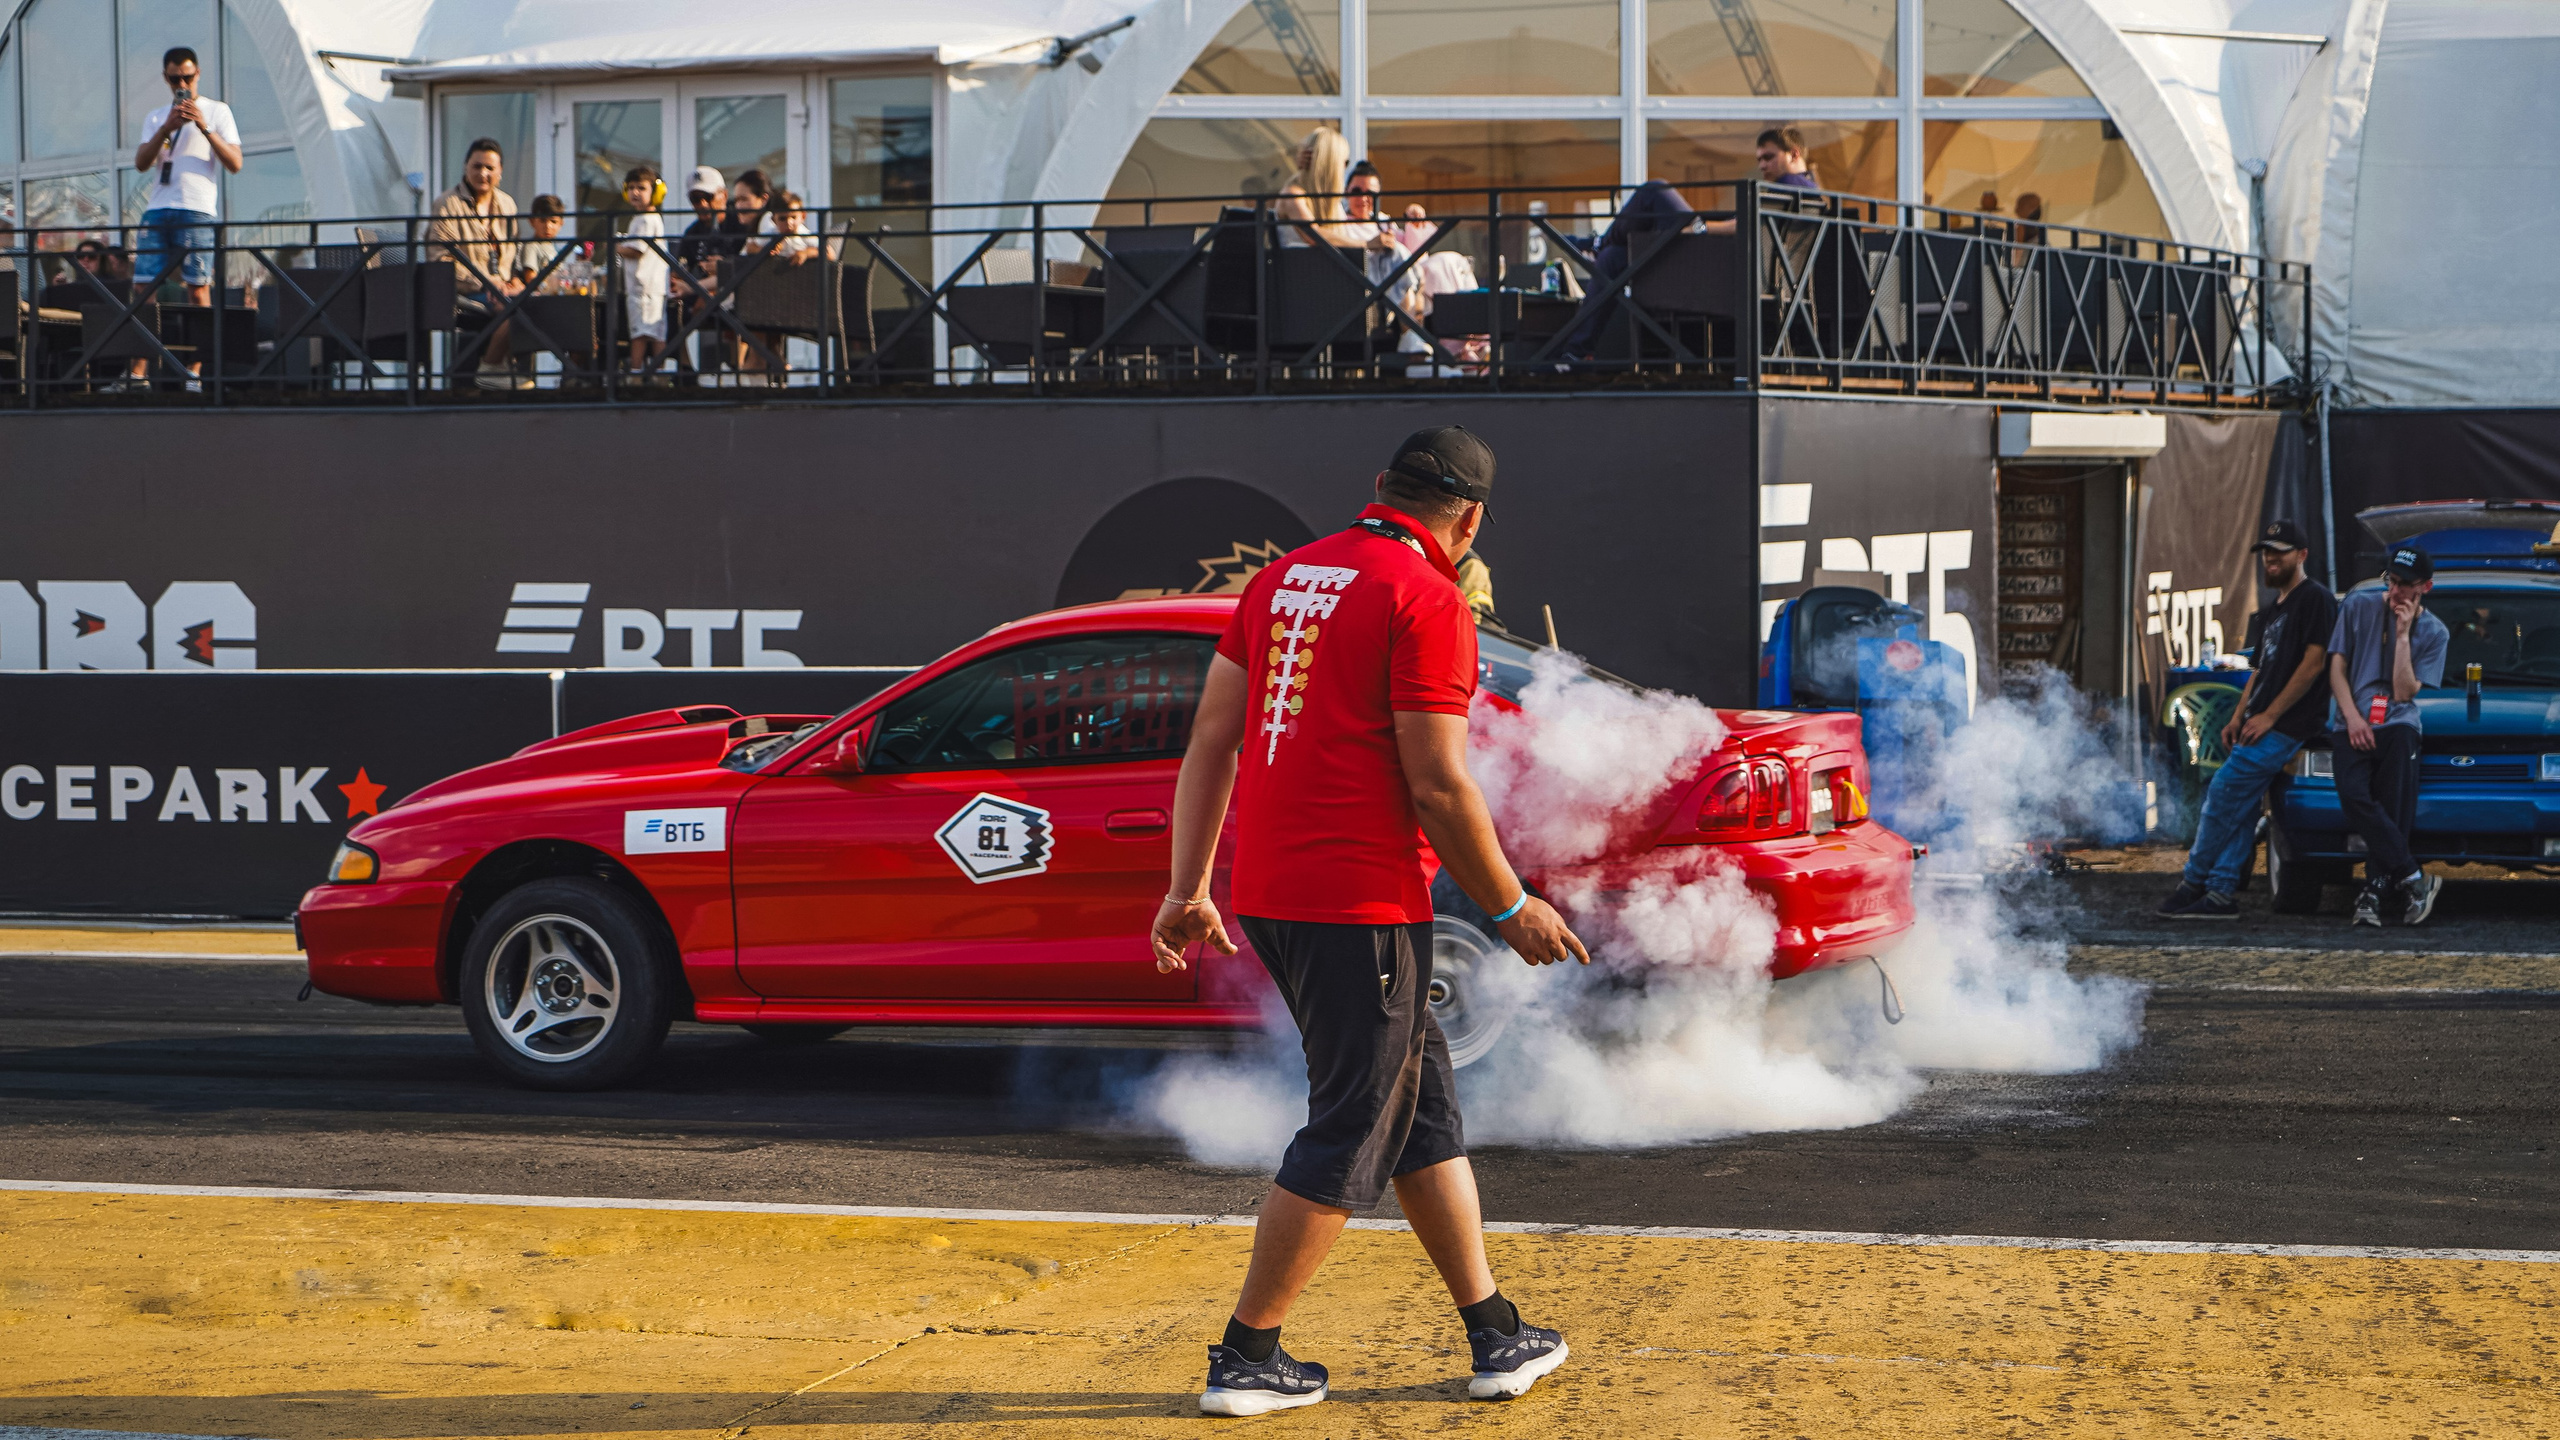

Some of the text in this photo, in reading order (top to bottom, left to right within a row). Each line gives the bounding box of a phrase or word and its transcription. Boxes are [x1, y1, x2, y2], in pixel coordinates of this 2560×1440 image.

[2171, 587, 2224, 668] ВТБ
[1, 764, 332, 824] CEPARK
[665, 822, 705, 842] ВТБ
[978, 826, 1009, 851] 81
